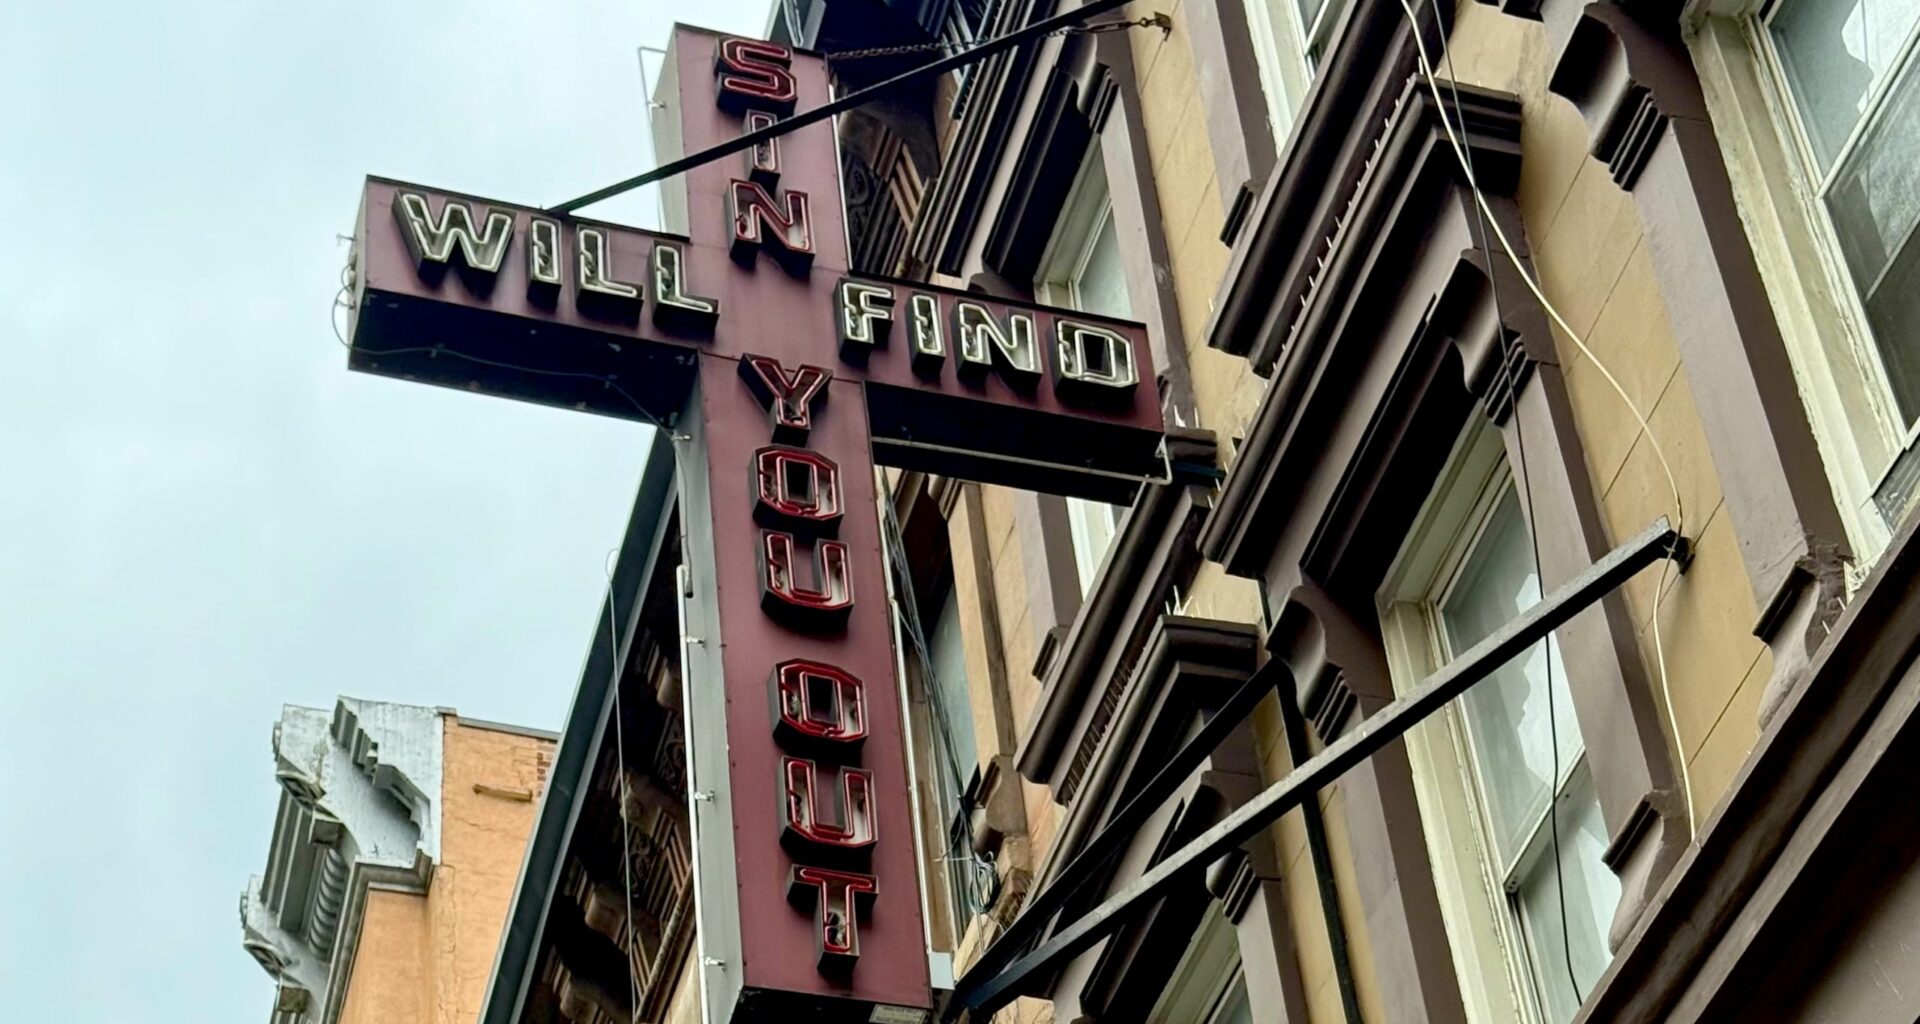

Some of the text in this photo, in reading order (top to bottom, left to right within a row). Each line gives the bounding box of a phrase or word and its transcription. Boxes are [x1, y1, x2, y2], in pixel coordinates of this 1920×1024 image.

[716, 36, 816, 270] SIN
[394, 190, 1139, 398] WILL FIND
[738, 353, 879, 970] YOU OUT
